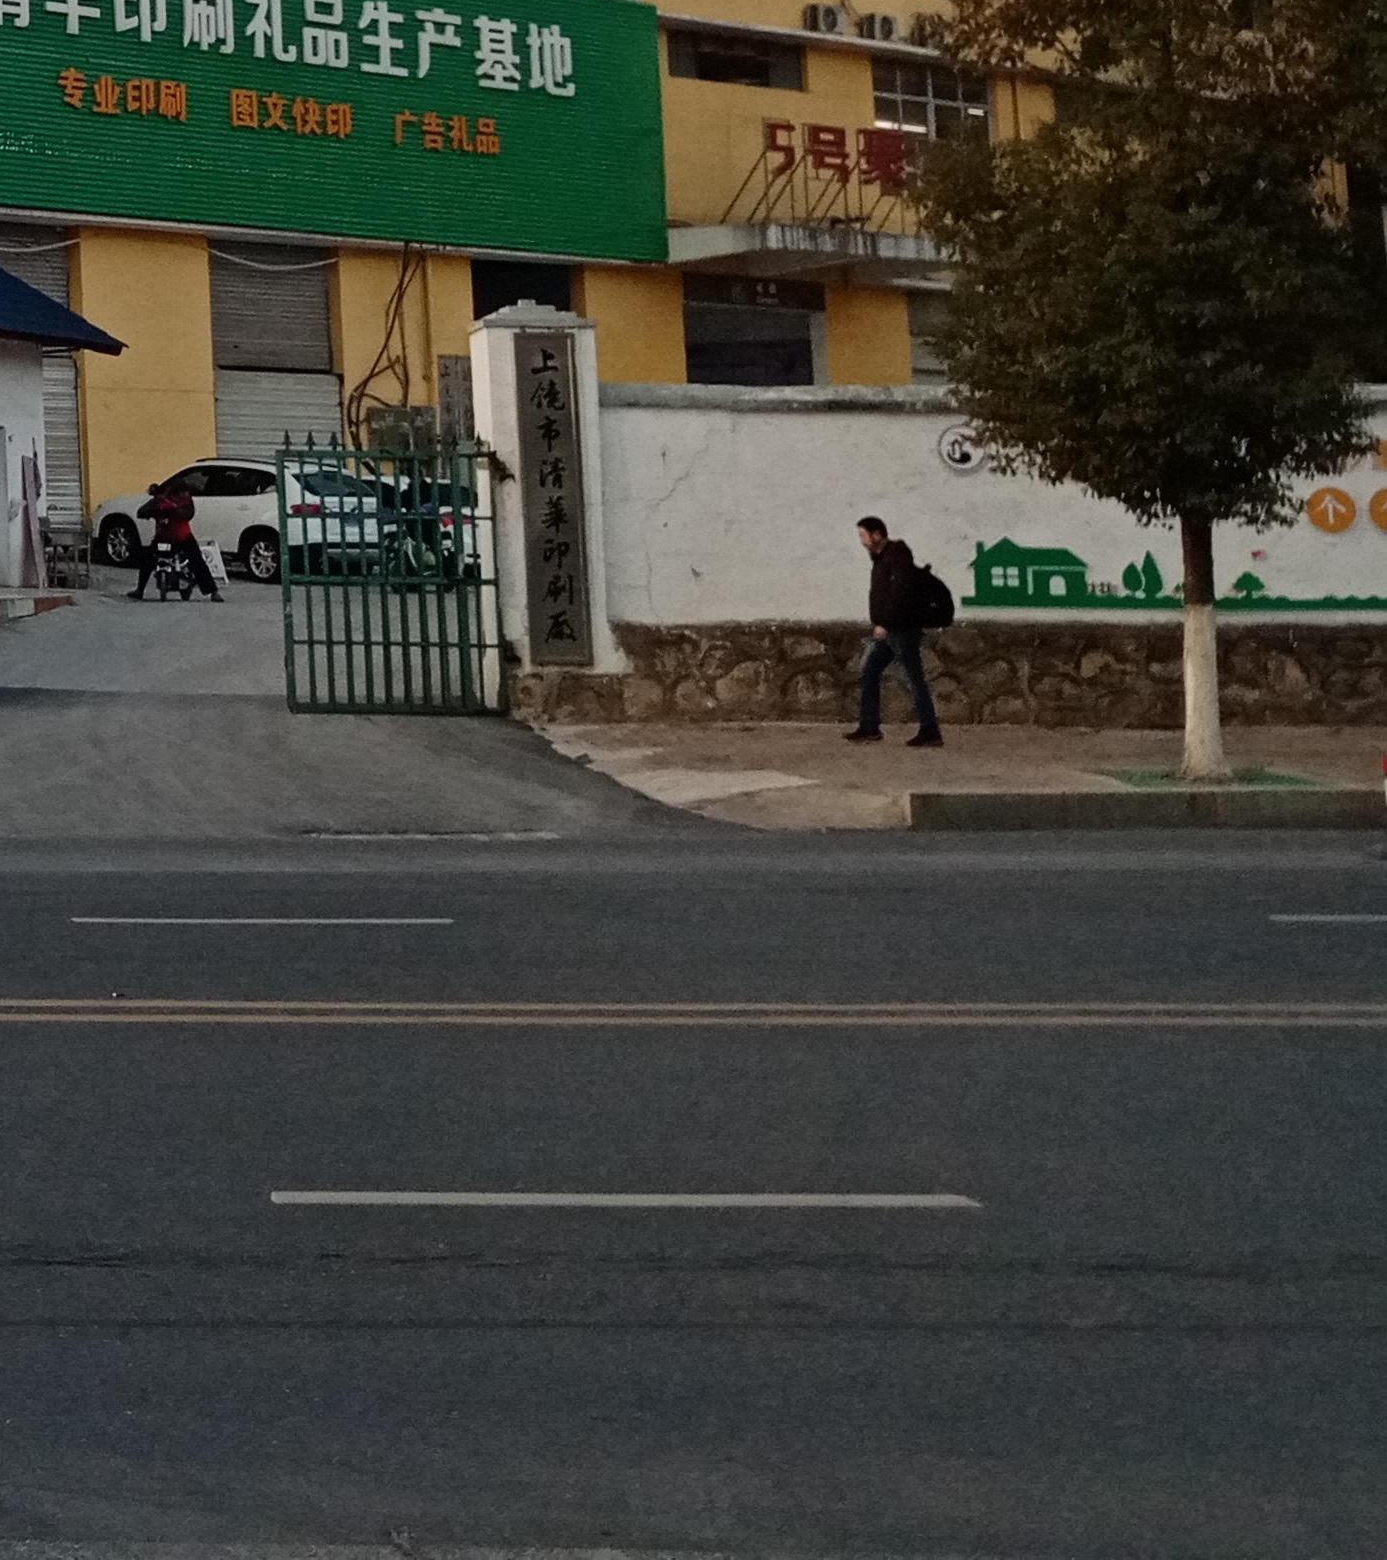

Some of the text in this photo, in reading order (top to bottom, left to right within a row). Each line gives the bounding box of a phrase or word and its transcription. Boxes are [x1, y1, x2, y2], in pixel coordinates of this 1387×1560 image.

[57, 67, 501, 156] 专业印刷 图文快印 广告礼品
